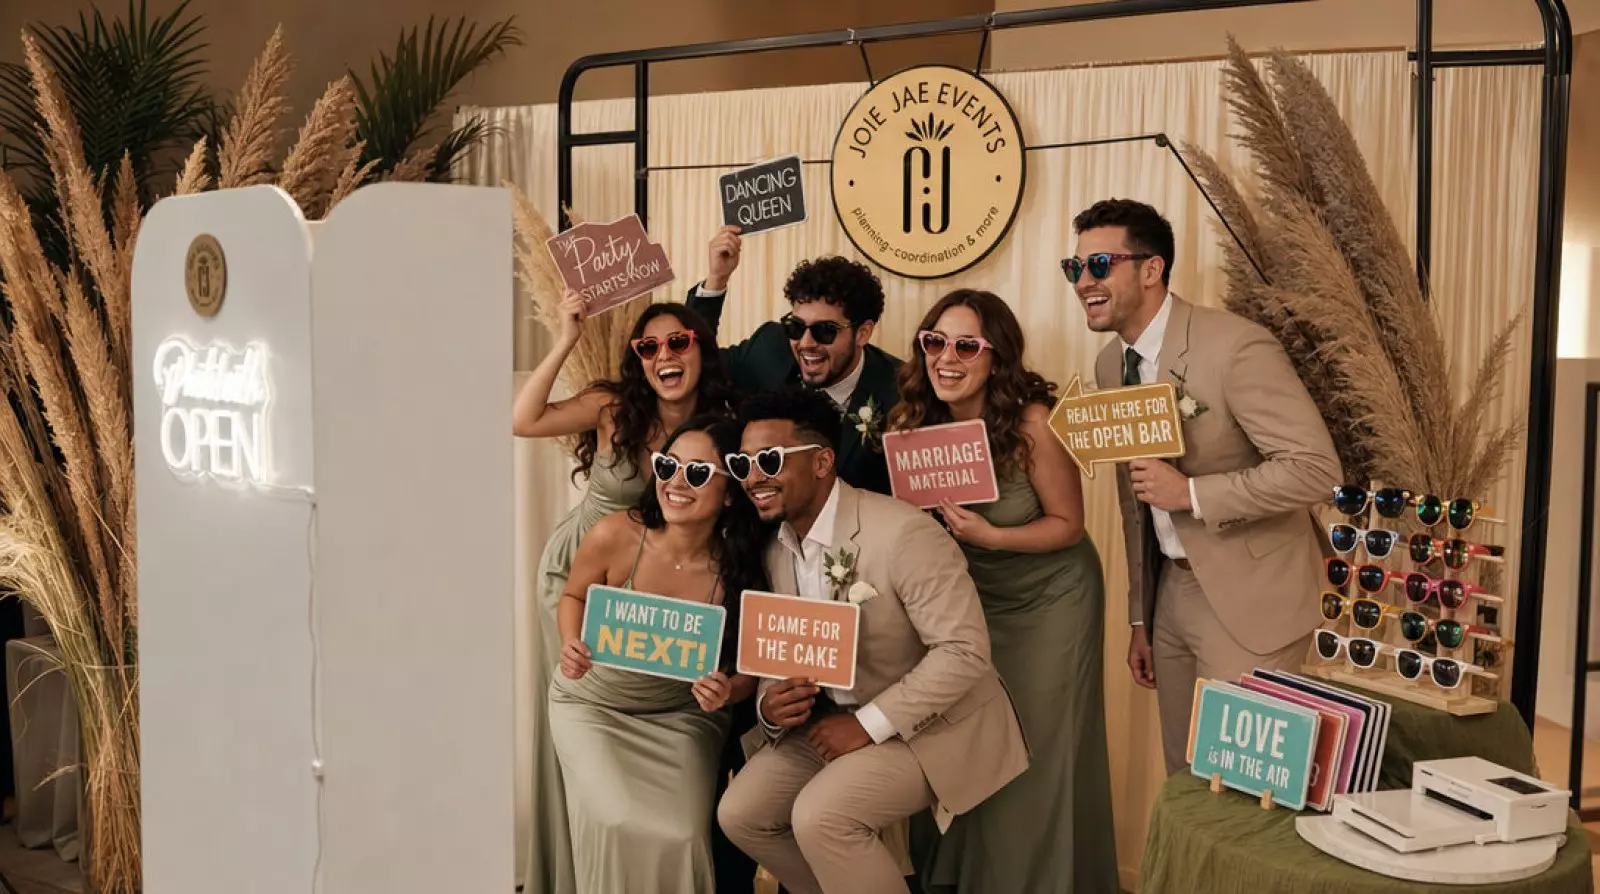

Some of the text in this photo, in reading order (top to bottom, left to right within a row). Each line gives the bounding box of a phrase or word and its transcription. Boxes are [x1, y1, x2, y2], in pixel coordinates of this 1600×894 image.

[850, 81, 1005, 158] JOIE JAE EVENTS
[725, 168, 797, 203] DANCING
[737, 194, 793, 226] QUEEN
[966, 235, 977, 248] &
[975, 206, 999, 237] more
[565, 234, 641, 285] Party
[581, 272, 629, 303] STARTS
[1066, 396, 1169, 425] REALLY HERE FOR
[161, 407, 266, 483] OPEN
[1067, 420, 1174, 450] THE OPEN BAR
[896, 441, 984, 471] MARRIAGE
[908, 467, 980, 492] MATERIAL
[605, 599, 704, 635] I WANT TO BE
[758, 613, 841, 641] I CAME FOR
[596, 624, 707, 671] NEXT!
[756, 637, 838, 669] THE CAKE
[1219, 703, 1289, 760] LOVE
[1207, 746, 1218, 765] is
[1219, 747, 1235, 772] IN
[1238, 754, 1262, 781] THE
[1265, 763, 1291, 789] AIR
